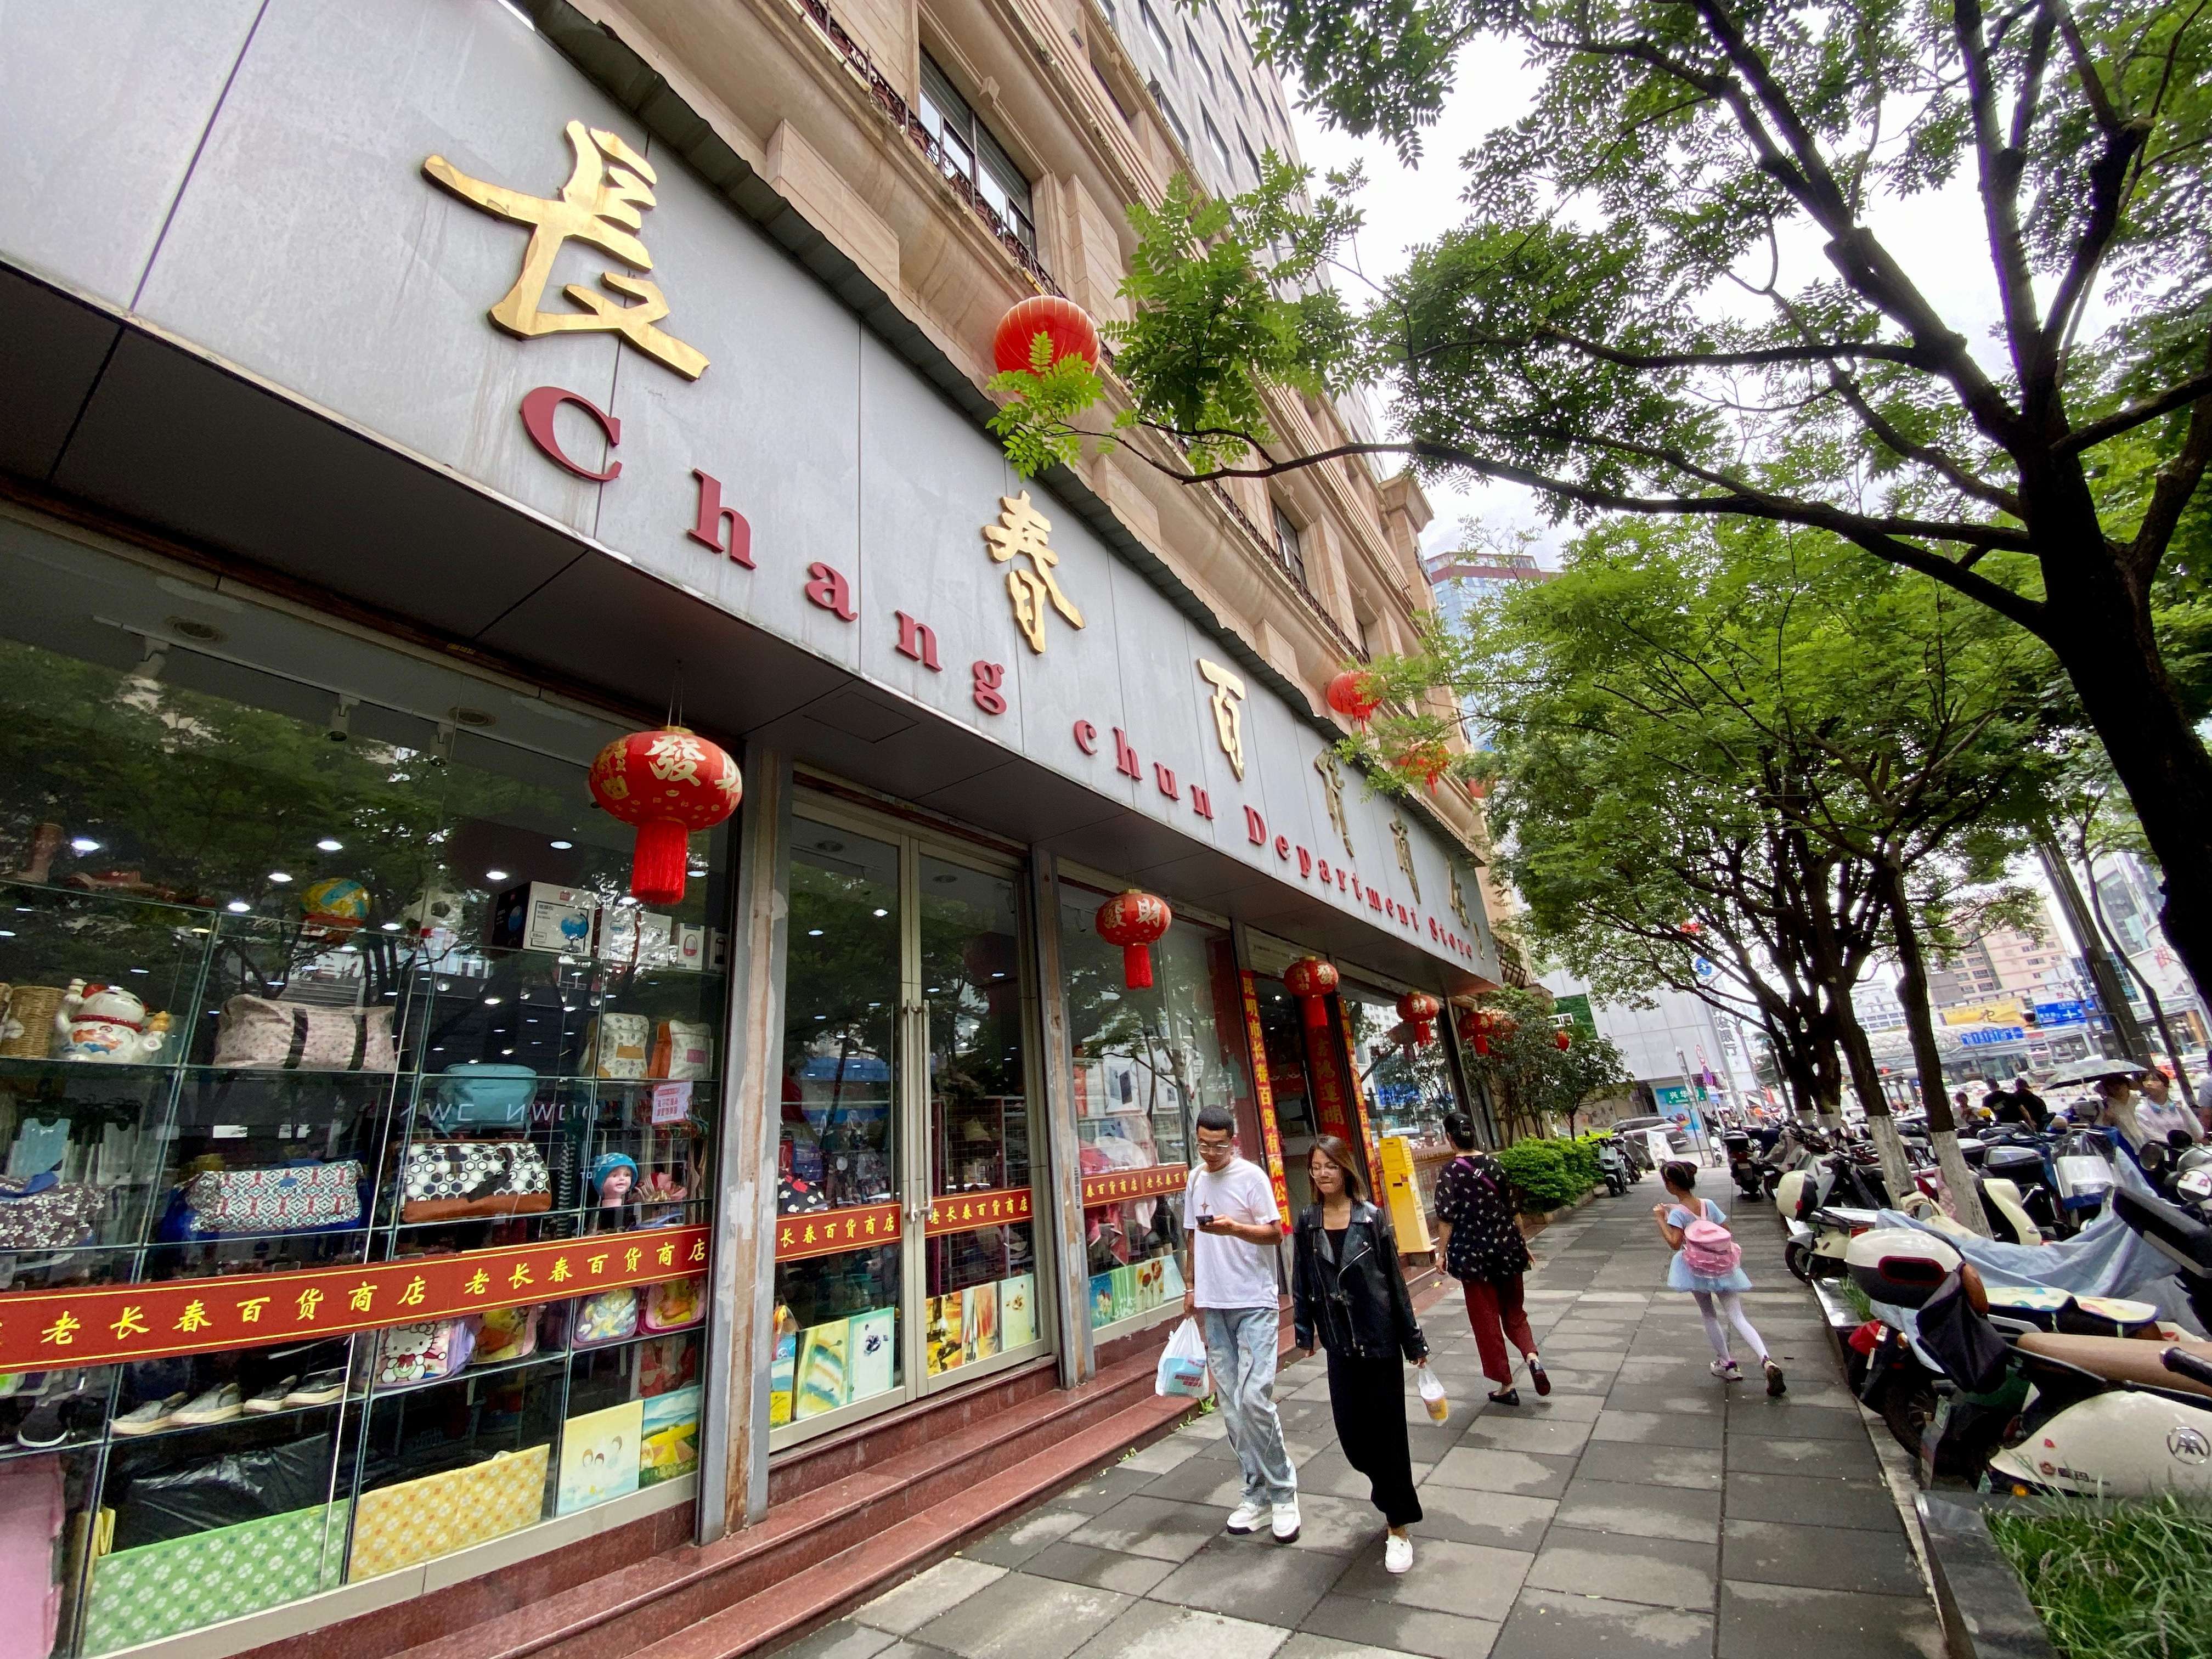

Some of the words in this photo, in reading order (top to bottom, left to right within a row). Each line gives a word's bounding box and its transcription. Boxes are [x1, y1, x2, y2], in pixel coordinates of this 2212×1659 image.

[520, 386, 1007, 715] Chang
[1073, 719, 1214, 821] chun
[1243, 804, 1419, 932] Department
[1428, 916, 1472, 960] Store
[1086, 1177, 1138, 1198] 春百货商店
[930, 1198, 1028, 1225] 老长春百货商店
[780, 1213, 895, 1248] 长春百货商店
[41, 1275, 426, 1345] 老长春百货商店
[464, 1238, 706, 1295] 老长春百货商店
